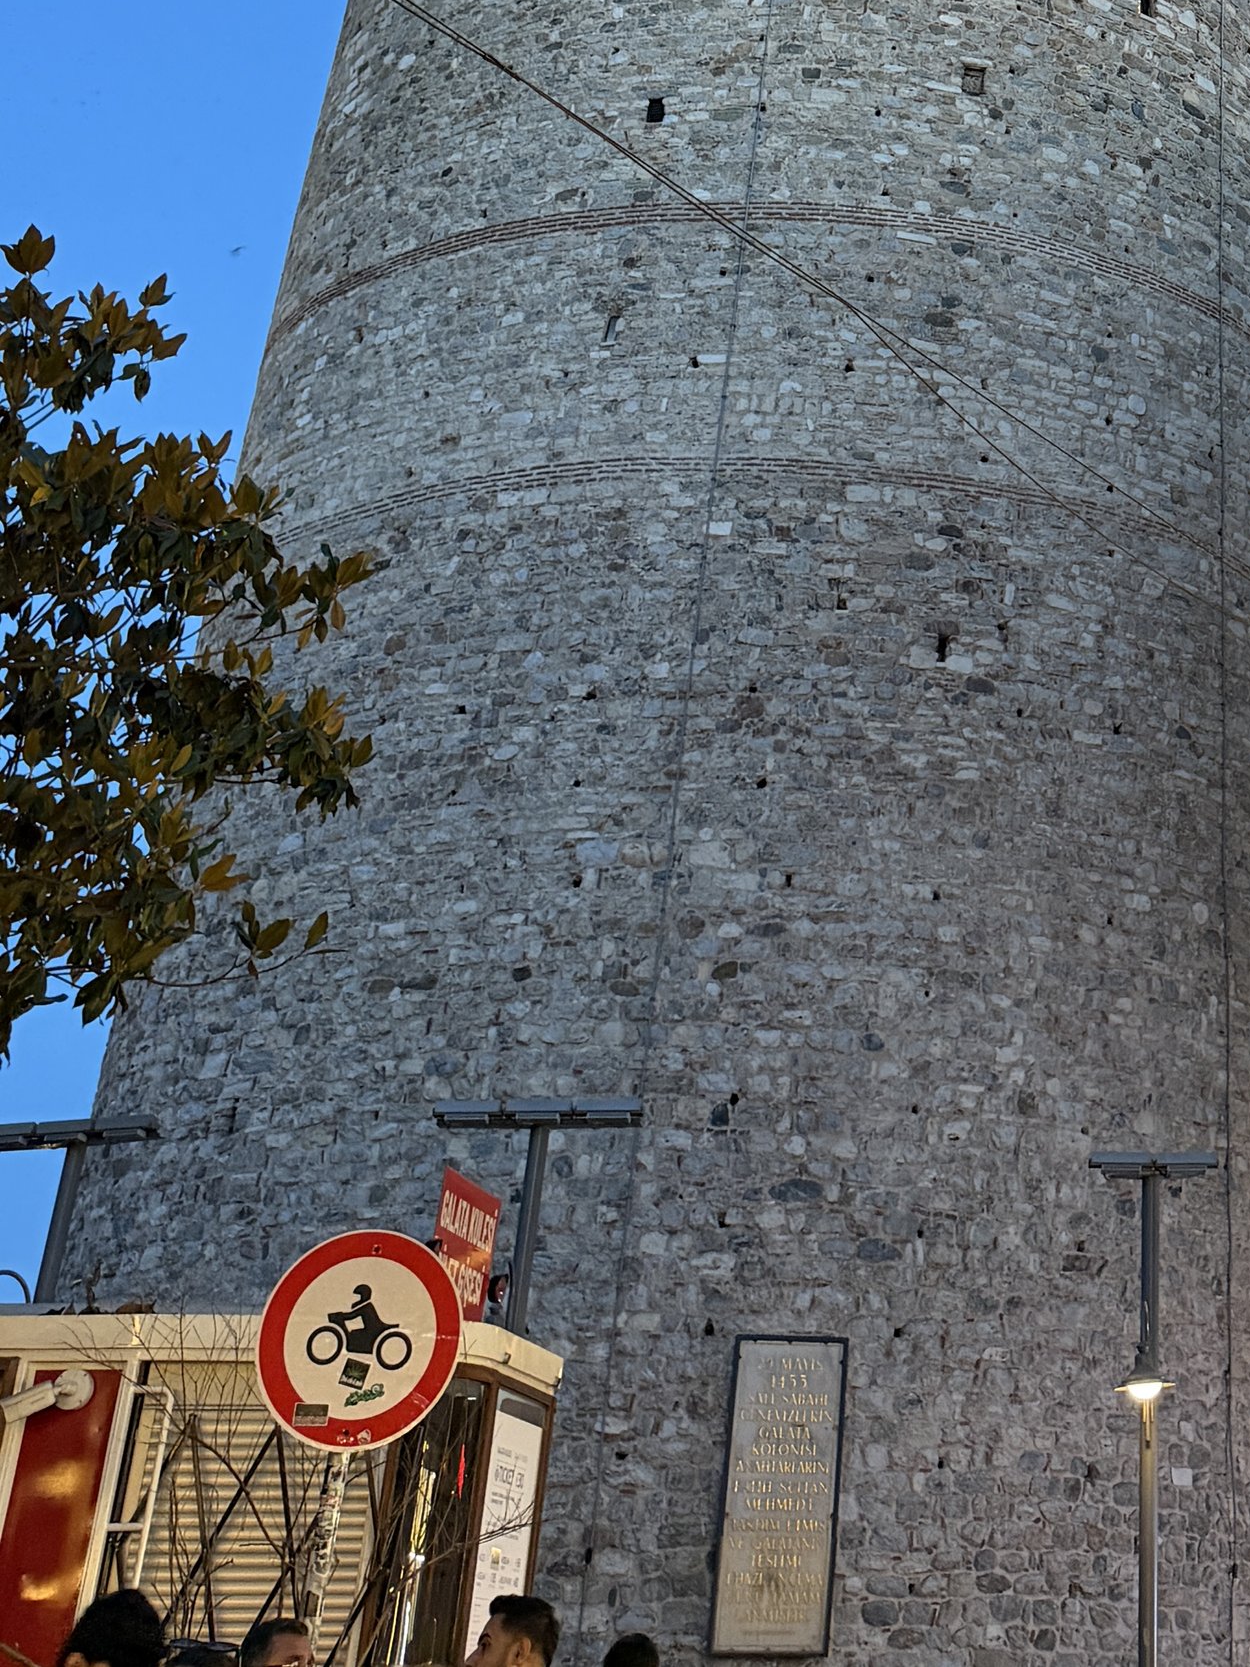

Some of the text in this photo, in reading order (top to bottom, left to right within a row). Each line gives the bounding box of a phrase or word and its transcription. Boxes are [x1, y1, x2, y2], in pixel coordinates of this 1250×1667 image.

[440, 1189, 498, 1253] GALATA KULESİ
[759, 1426, 811, 1439] GALATA
